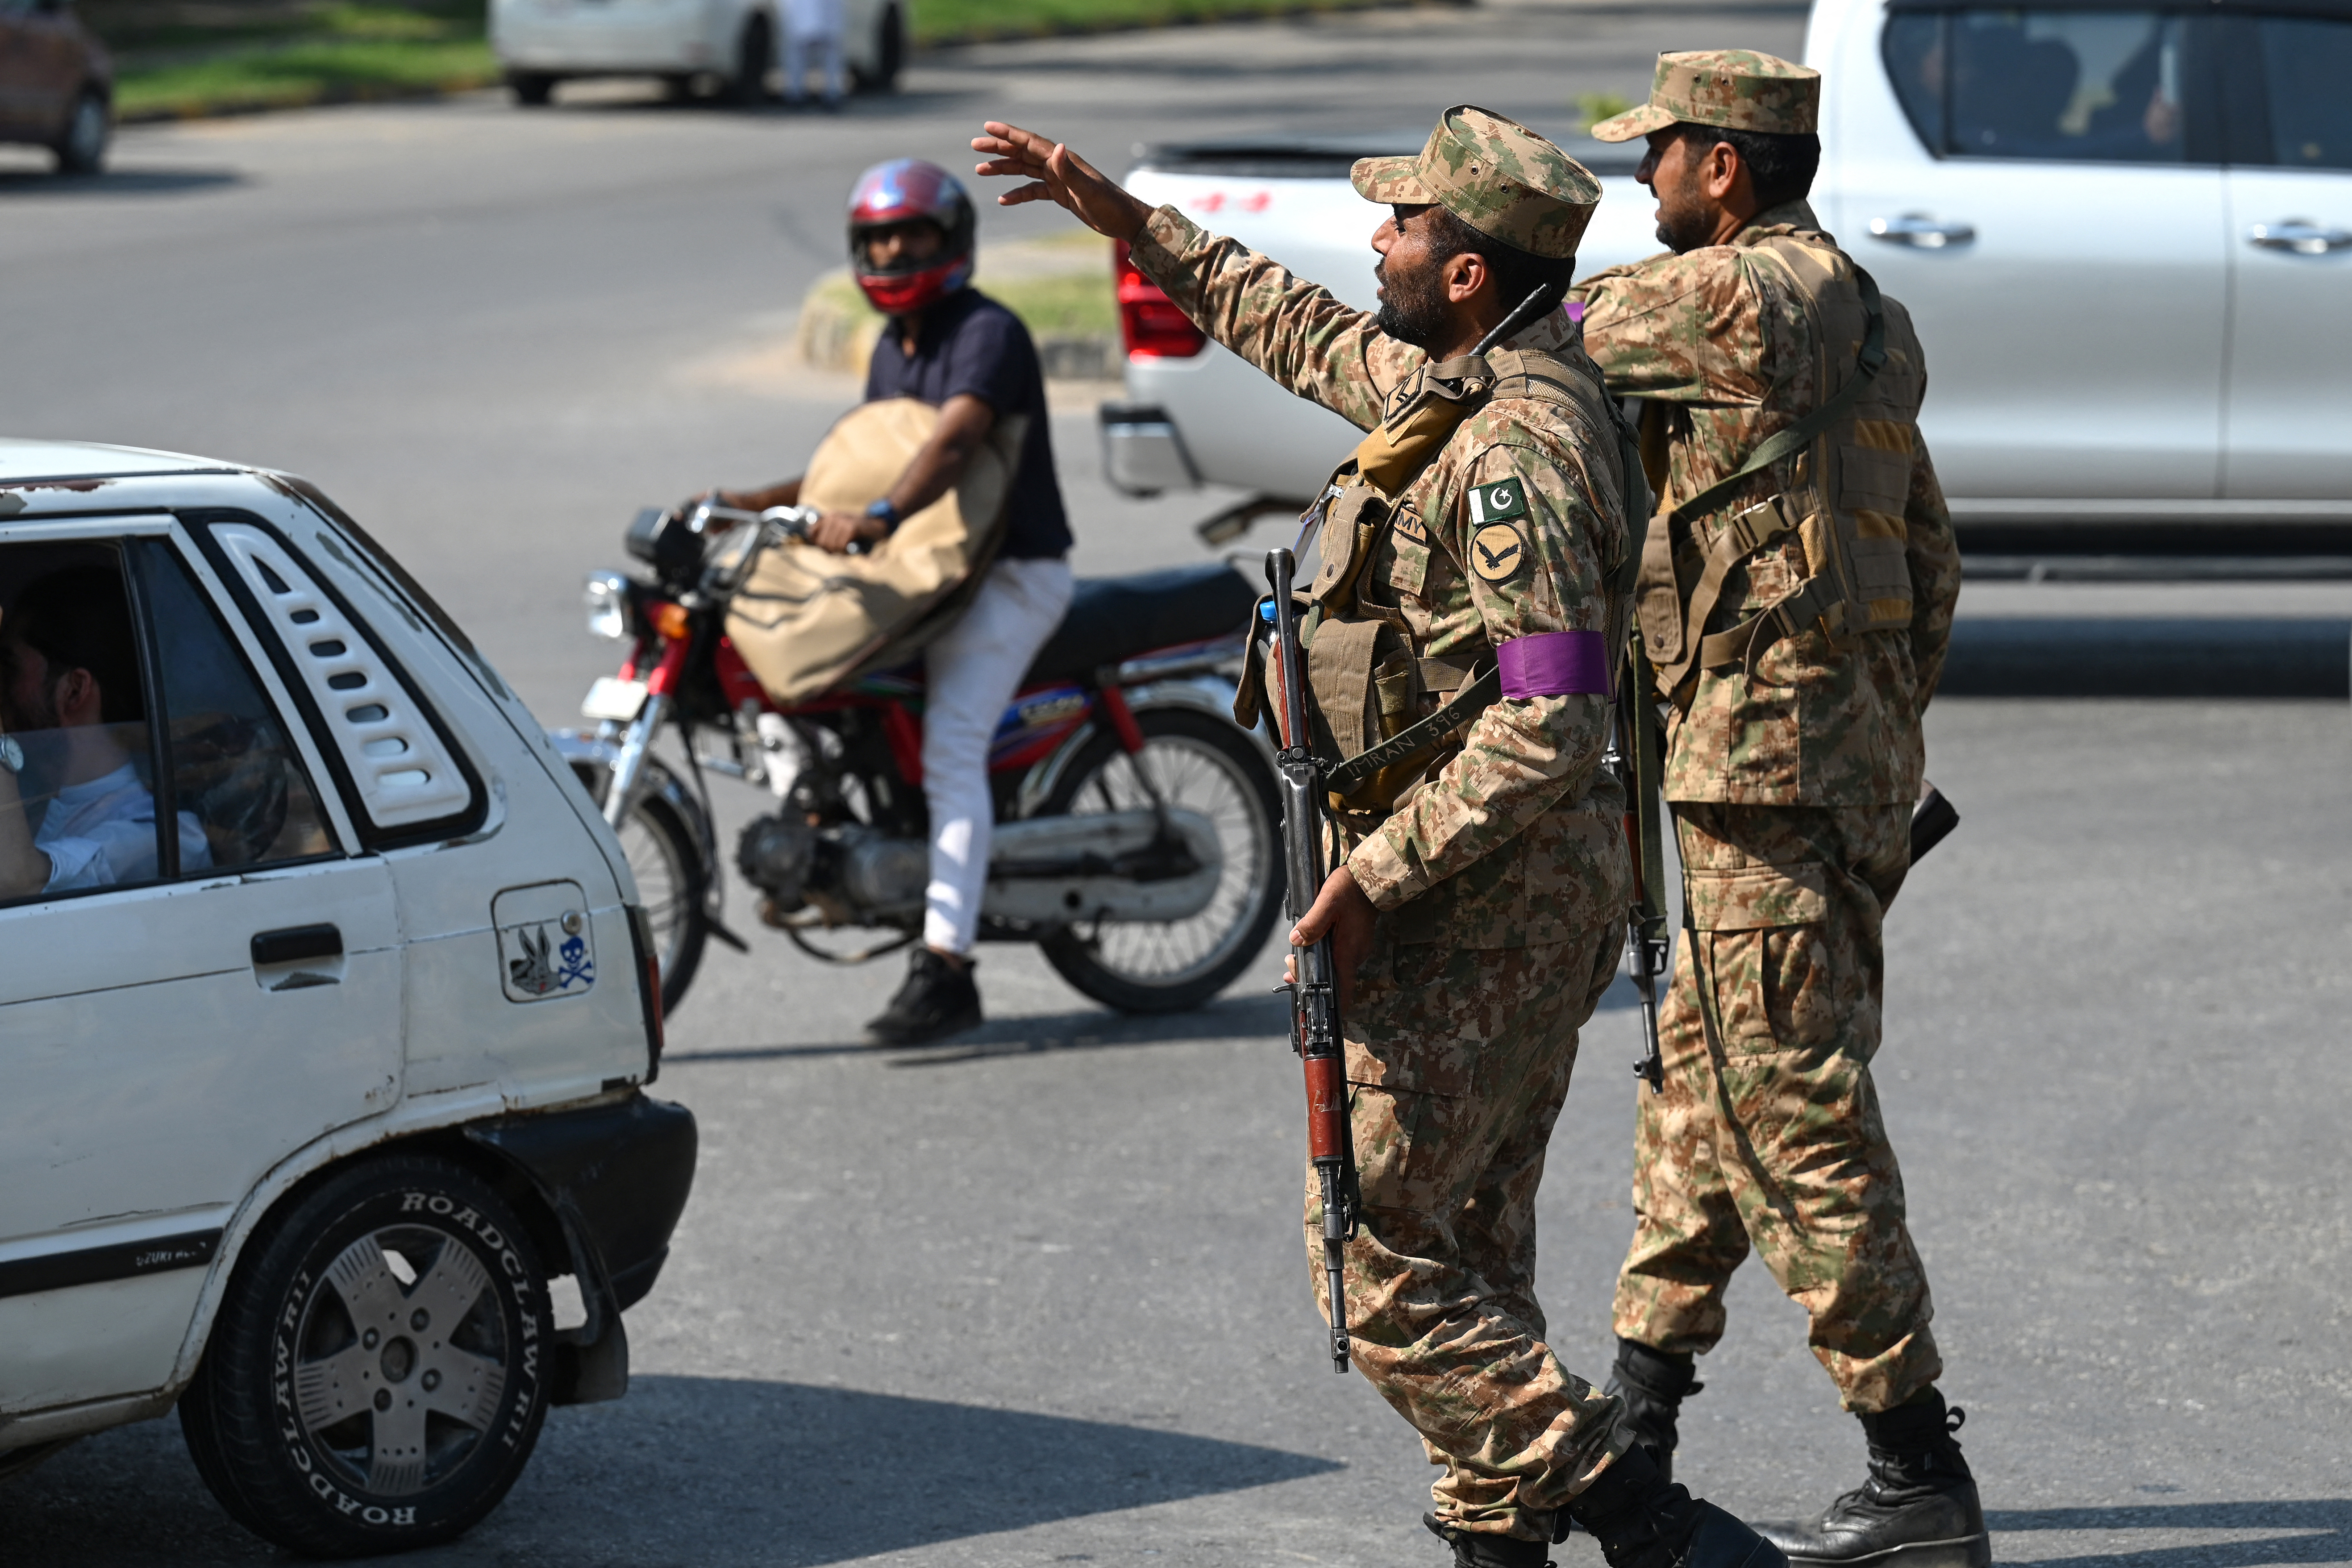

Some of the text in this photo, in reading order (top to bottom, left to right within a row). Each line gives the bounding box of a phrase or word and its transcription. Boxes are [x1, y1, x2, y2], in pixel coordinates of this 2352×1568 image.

[1346, 707, 1460, 777] IMRAN 396
[400, 1192, 538, 1381] ROADCLAW
[275, 1334, 416, 1525] ROADCLAW
